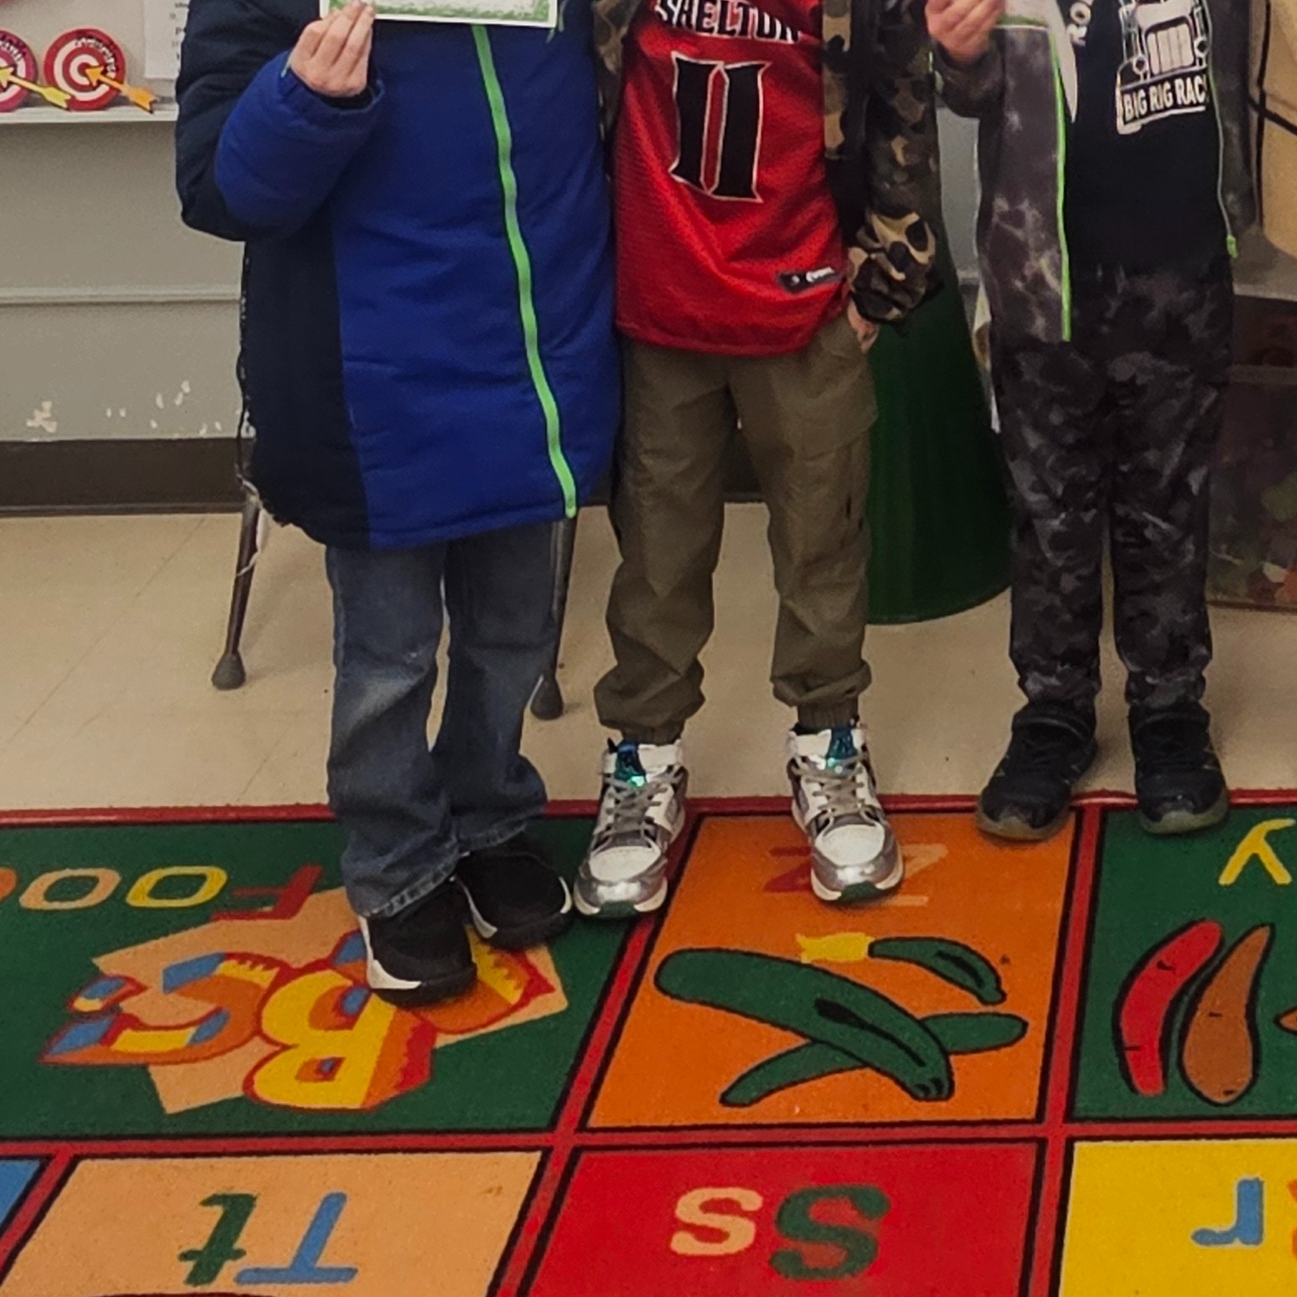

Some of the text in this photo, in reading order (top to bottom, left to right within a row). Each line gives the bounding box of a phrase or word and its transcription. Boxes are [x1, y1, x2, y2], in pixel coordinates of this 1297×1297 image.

[1123, 75, 1208, 122] BIG RIG RAC
[178, 1191, 358, 1285] Tt
[670, 1183, 891, 1281] Ss
